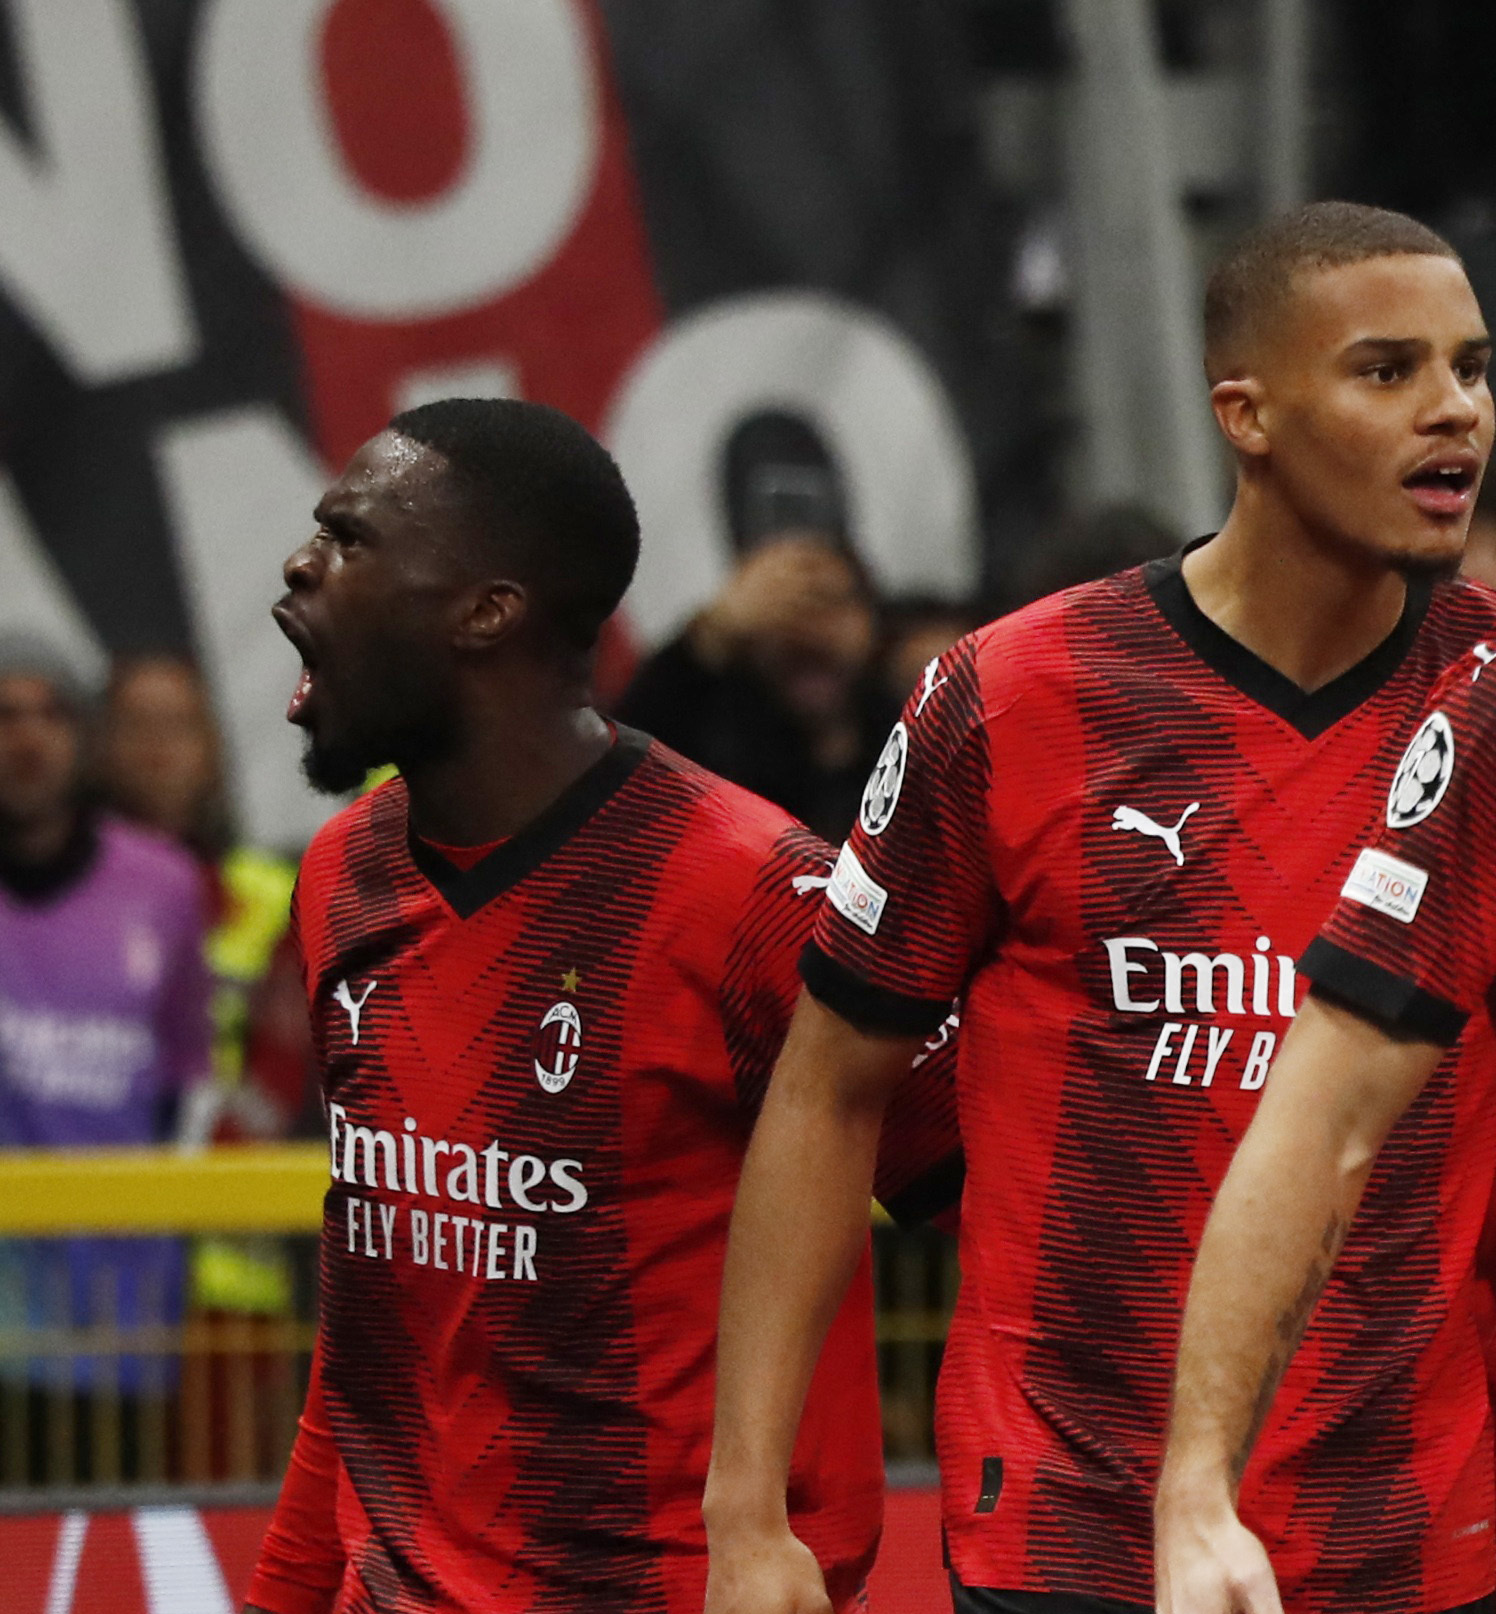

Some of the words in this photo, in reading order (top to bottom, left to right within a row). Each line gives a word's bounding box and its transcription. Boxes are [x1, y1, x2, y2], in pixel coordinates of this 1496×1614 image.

[1103, 935, 1297, 1018] Emir
[1145, 1022, 1234, 1088] FLY
[329, 1102, 588, 1213] Emirates
[347, 1197, 397, 1260] FLY
[410, 1209, 538, 1281] BETTER
